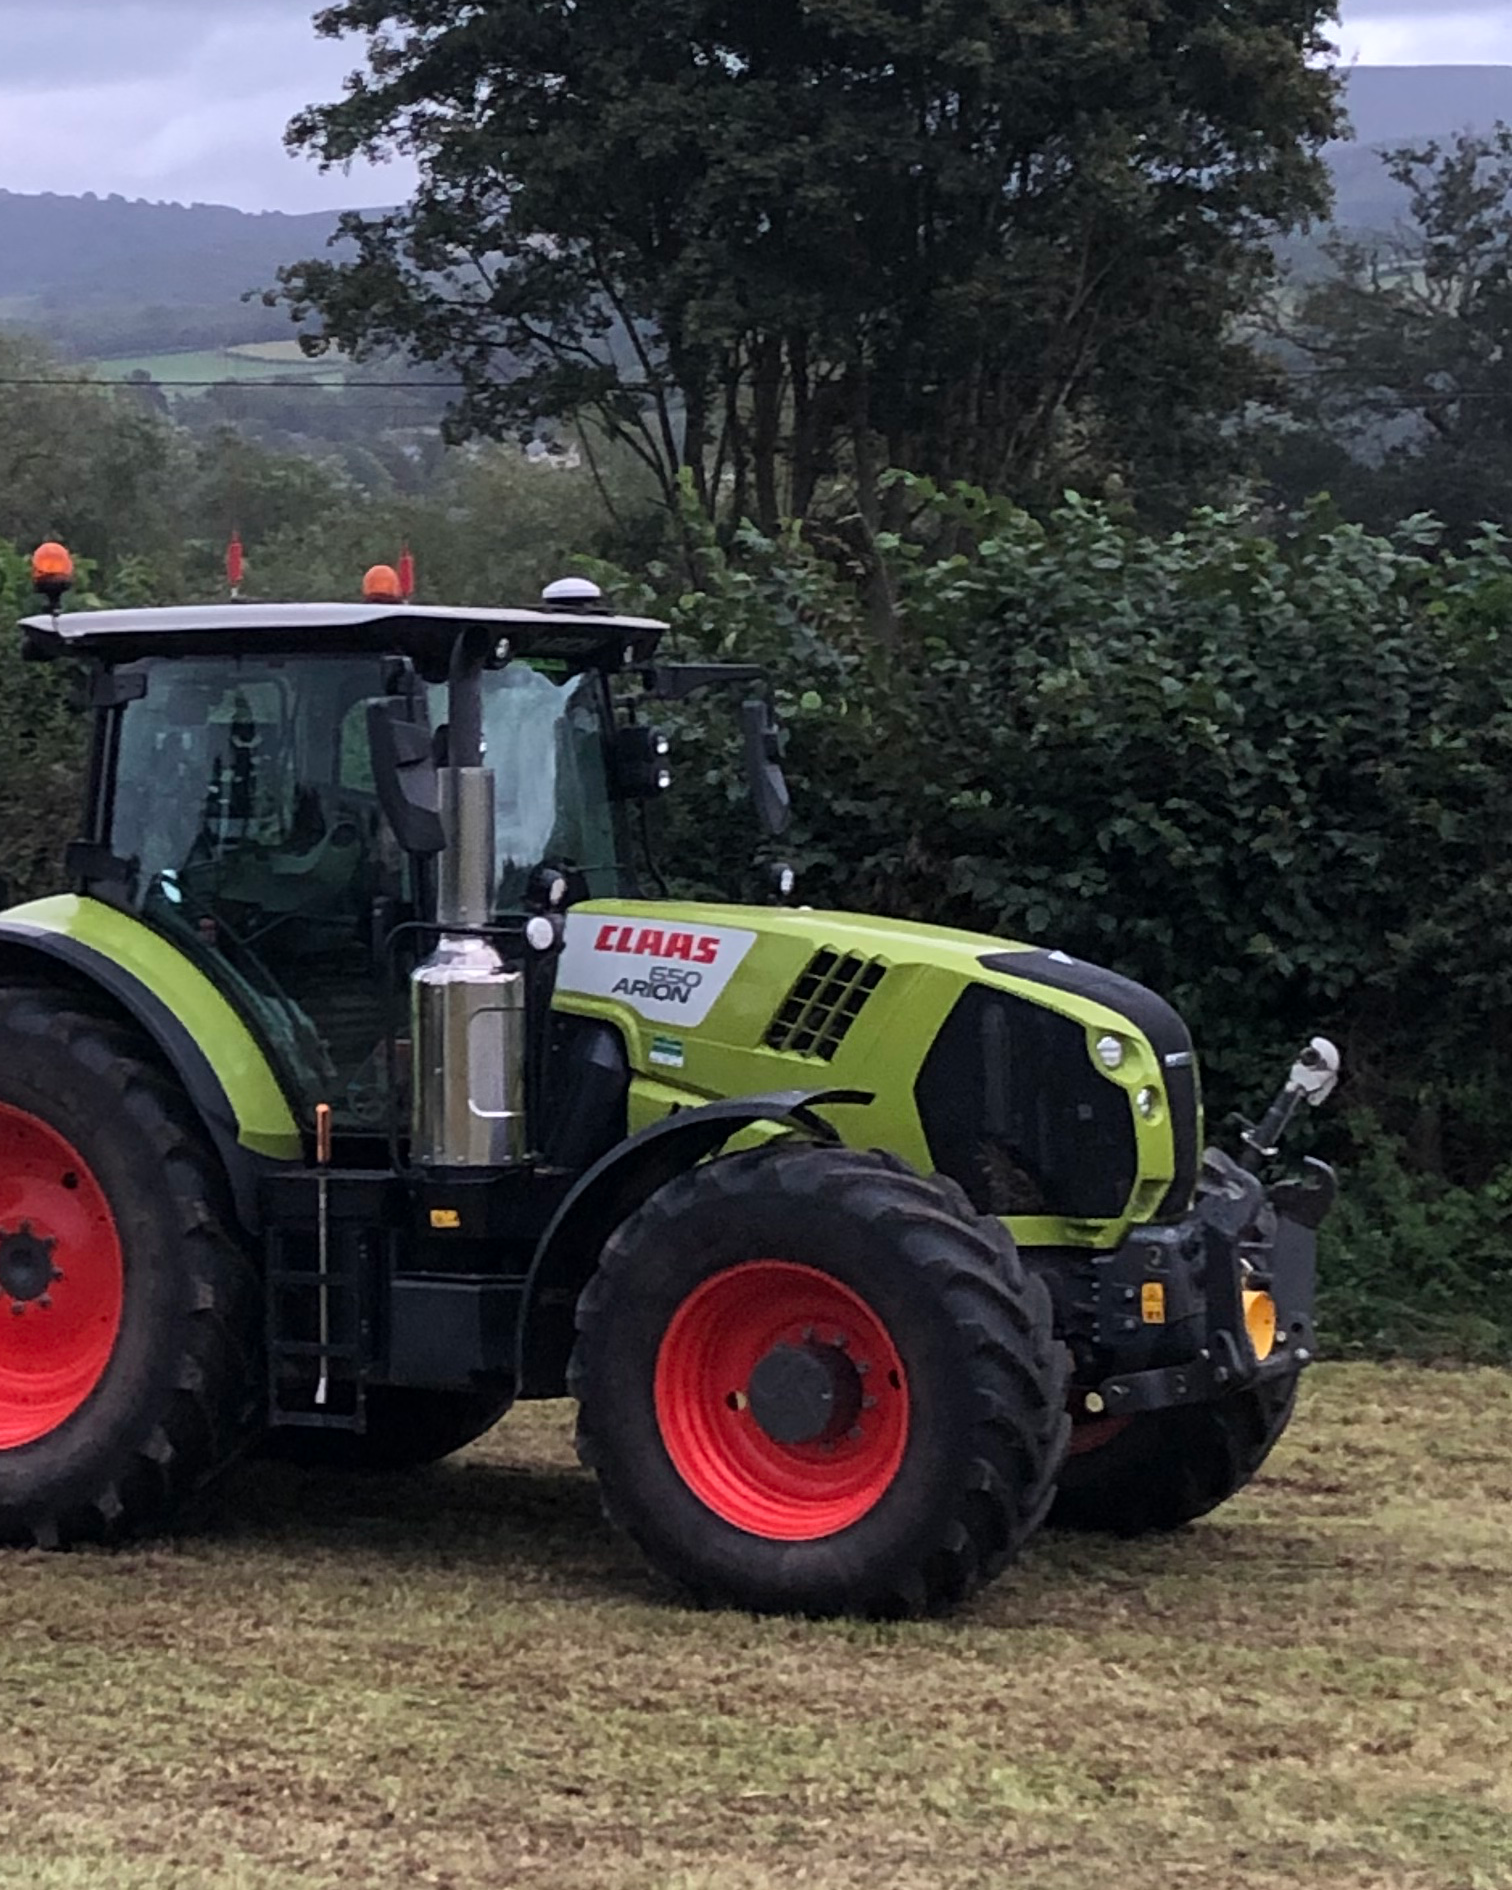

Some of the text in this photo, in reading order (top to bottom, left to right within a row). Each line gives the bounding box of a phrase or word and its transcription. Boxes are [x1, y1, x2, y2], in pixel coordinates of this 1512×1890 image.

[594, 925, 721, 964] CLAAS
[649, 966, 702, 988] 650
[611, 978, 691, 1004] ARION
